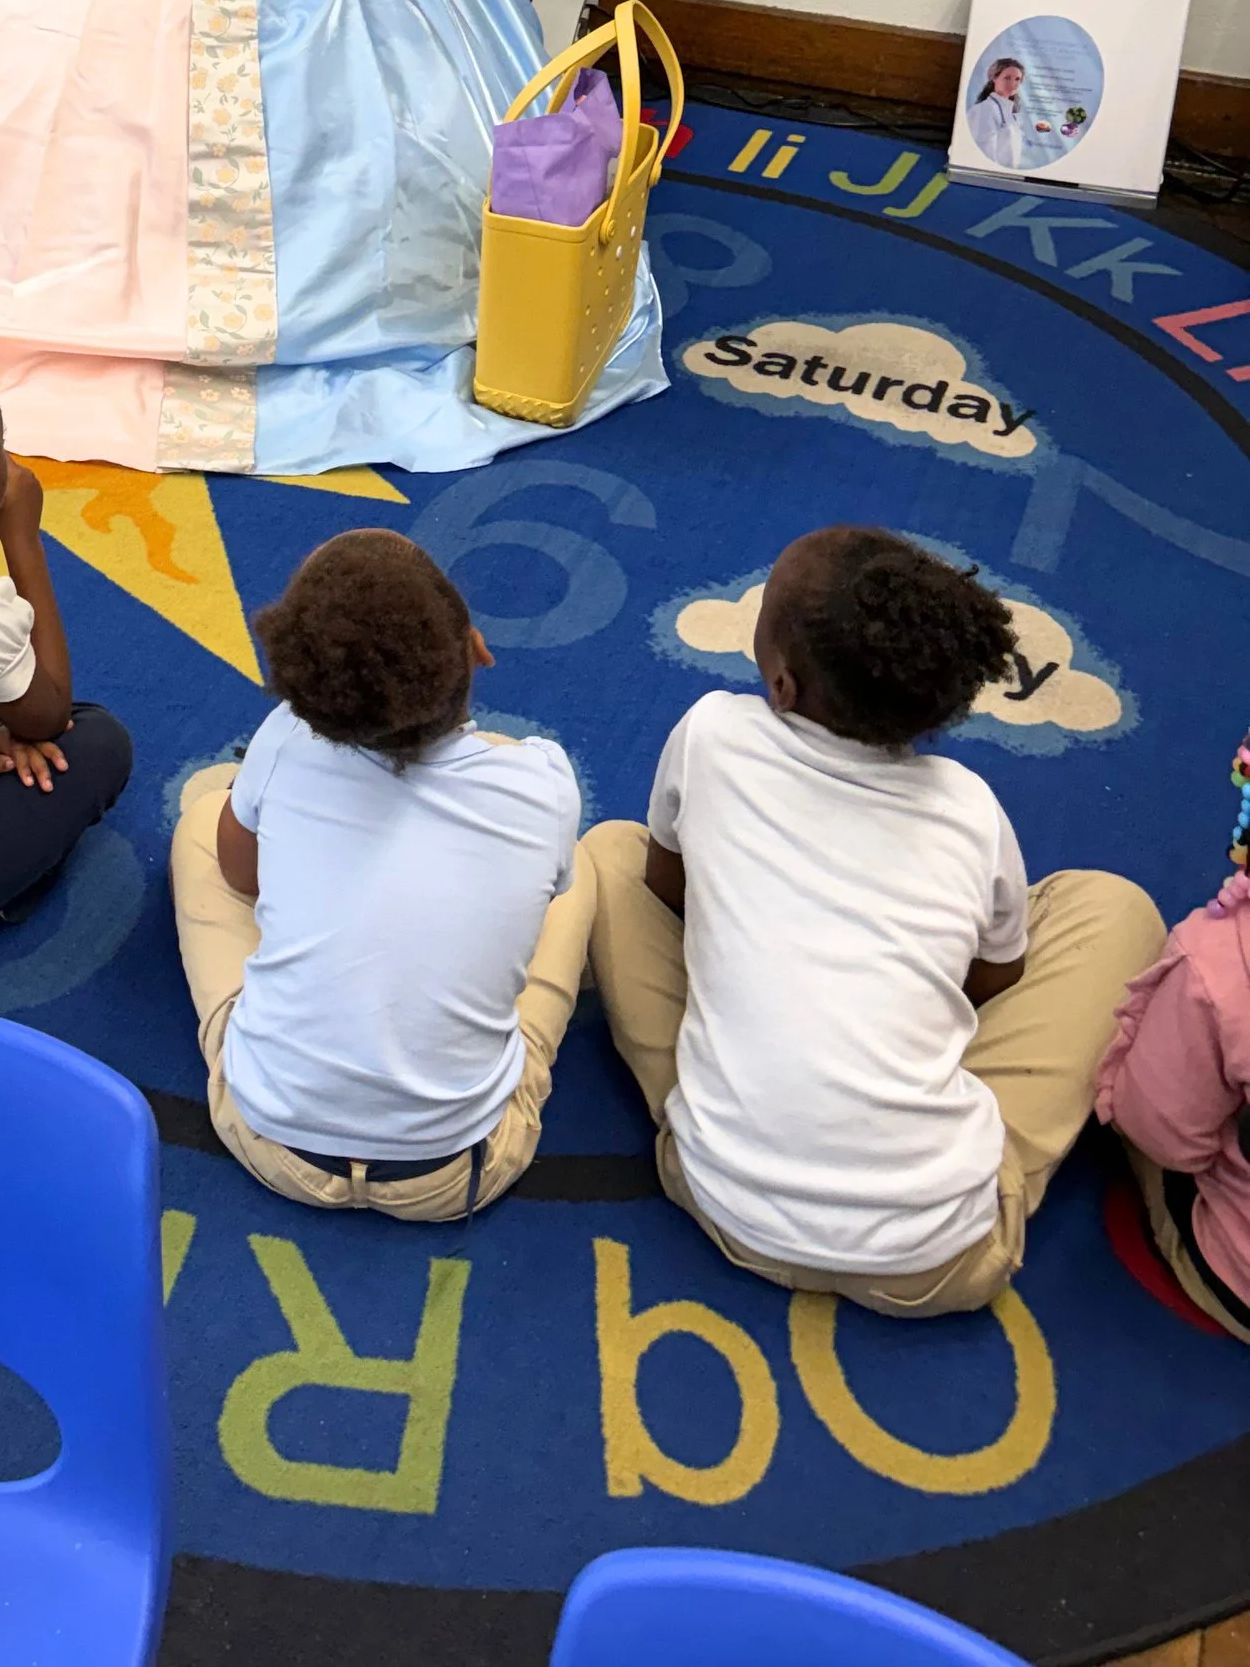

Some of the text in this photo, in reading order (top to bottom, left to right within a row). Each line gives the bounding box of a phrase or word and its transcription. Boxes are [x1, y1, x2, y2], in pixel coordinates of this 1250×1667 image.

[829, 152, 949, 218] Jj
[963, 196, 1183, 303] Kk
[704, 334, 1037, 437] Saturday
